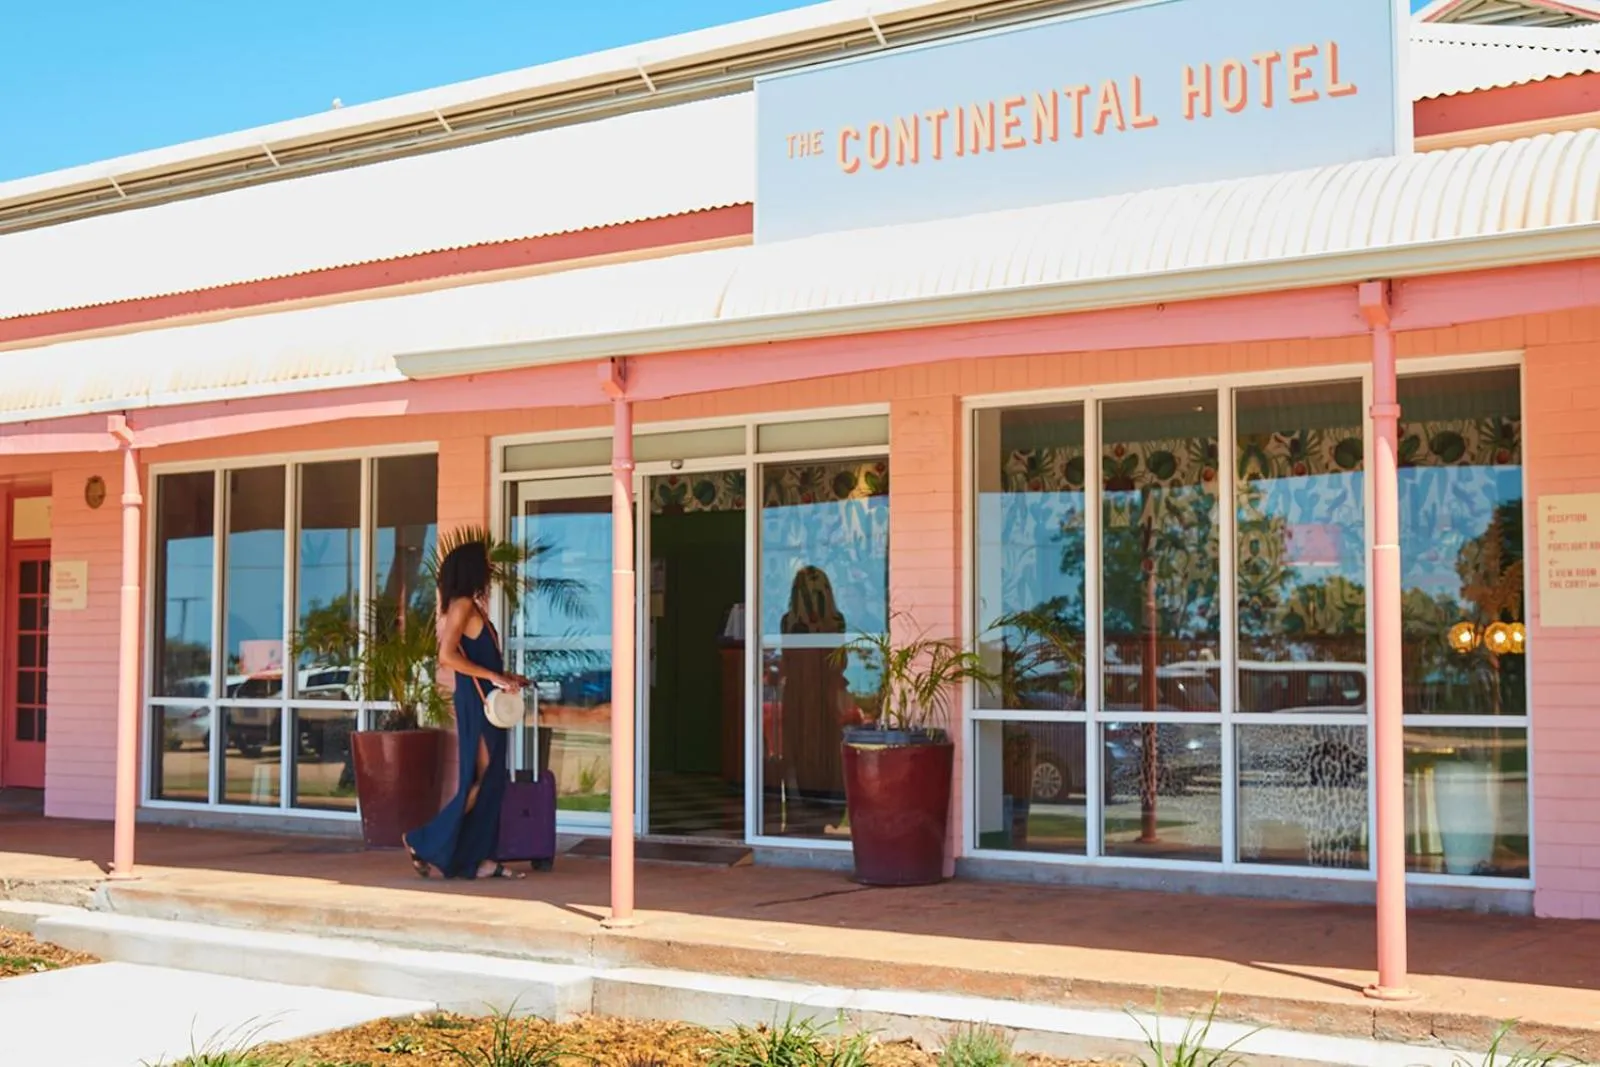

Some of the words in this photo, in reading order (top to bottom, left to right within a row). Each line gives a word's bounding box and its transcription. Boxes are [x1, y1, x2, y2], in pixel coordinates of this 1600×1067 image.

[786, 130, 825, 159] THE
[837, 74, 1159, 174] CONTINENTAL
[1182, 40, 1358, 121] HOTEL
[1547, 514, 1587, 522] RECEPTION
[1576, 568, 1597, 577] ROOM
